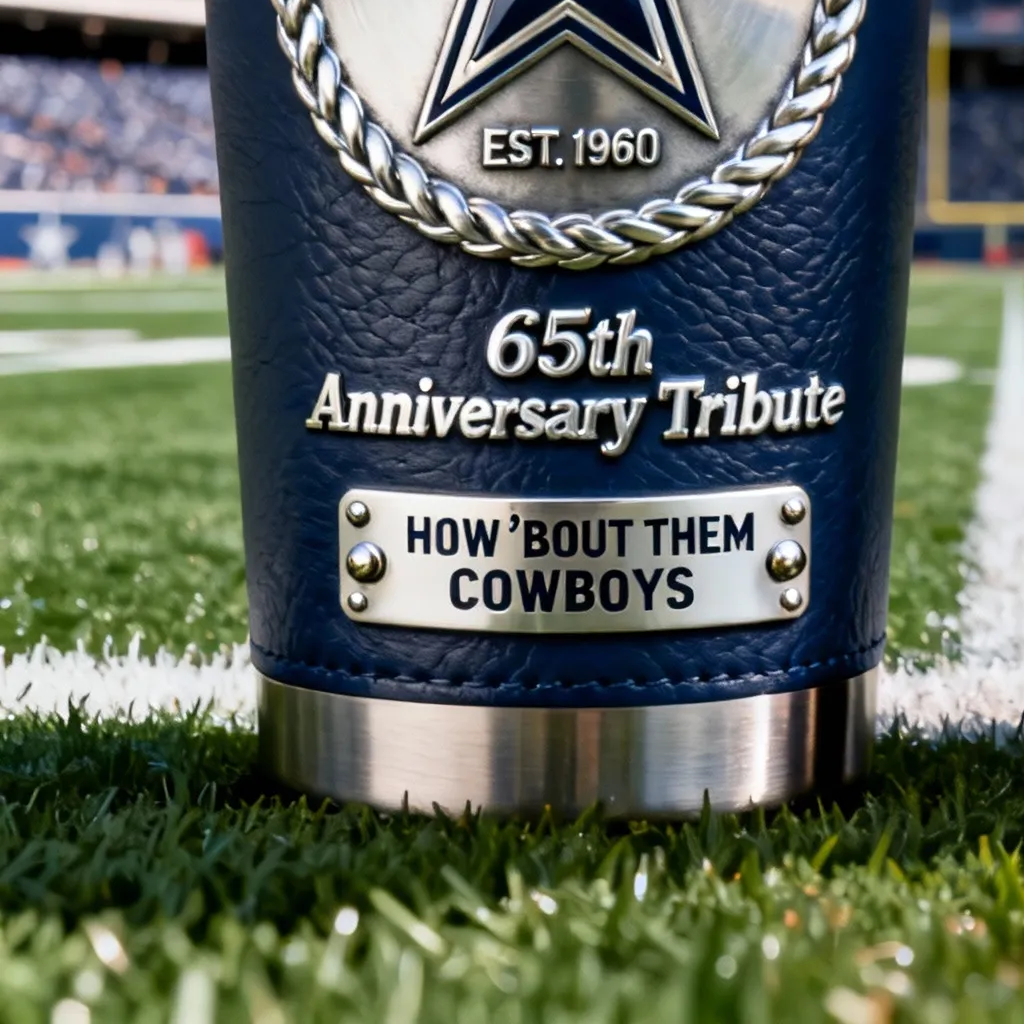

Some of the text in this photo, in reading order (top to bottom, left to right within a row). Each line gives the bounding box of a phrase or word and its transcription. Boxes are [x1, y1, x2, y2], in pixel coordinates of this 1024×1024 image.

[482, 127, 660, 168] EST. 1960
[485, 307, 654, 378] 65th
[305, 373, 846, 457] Anniversary Tribute
[406, 512, 756, 558] HOW 'BOUT THEM
[449, 567, 696, 613] COWBOYS
